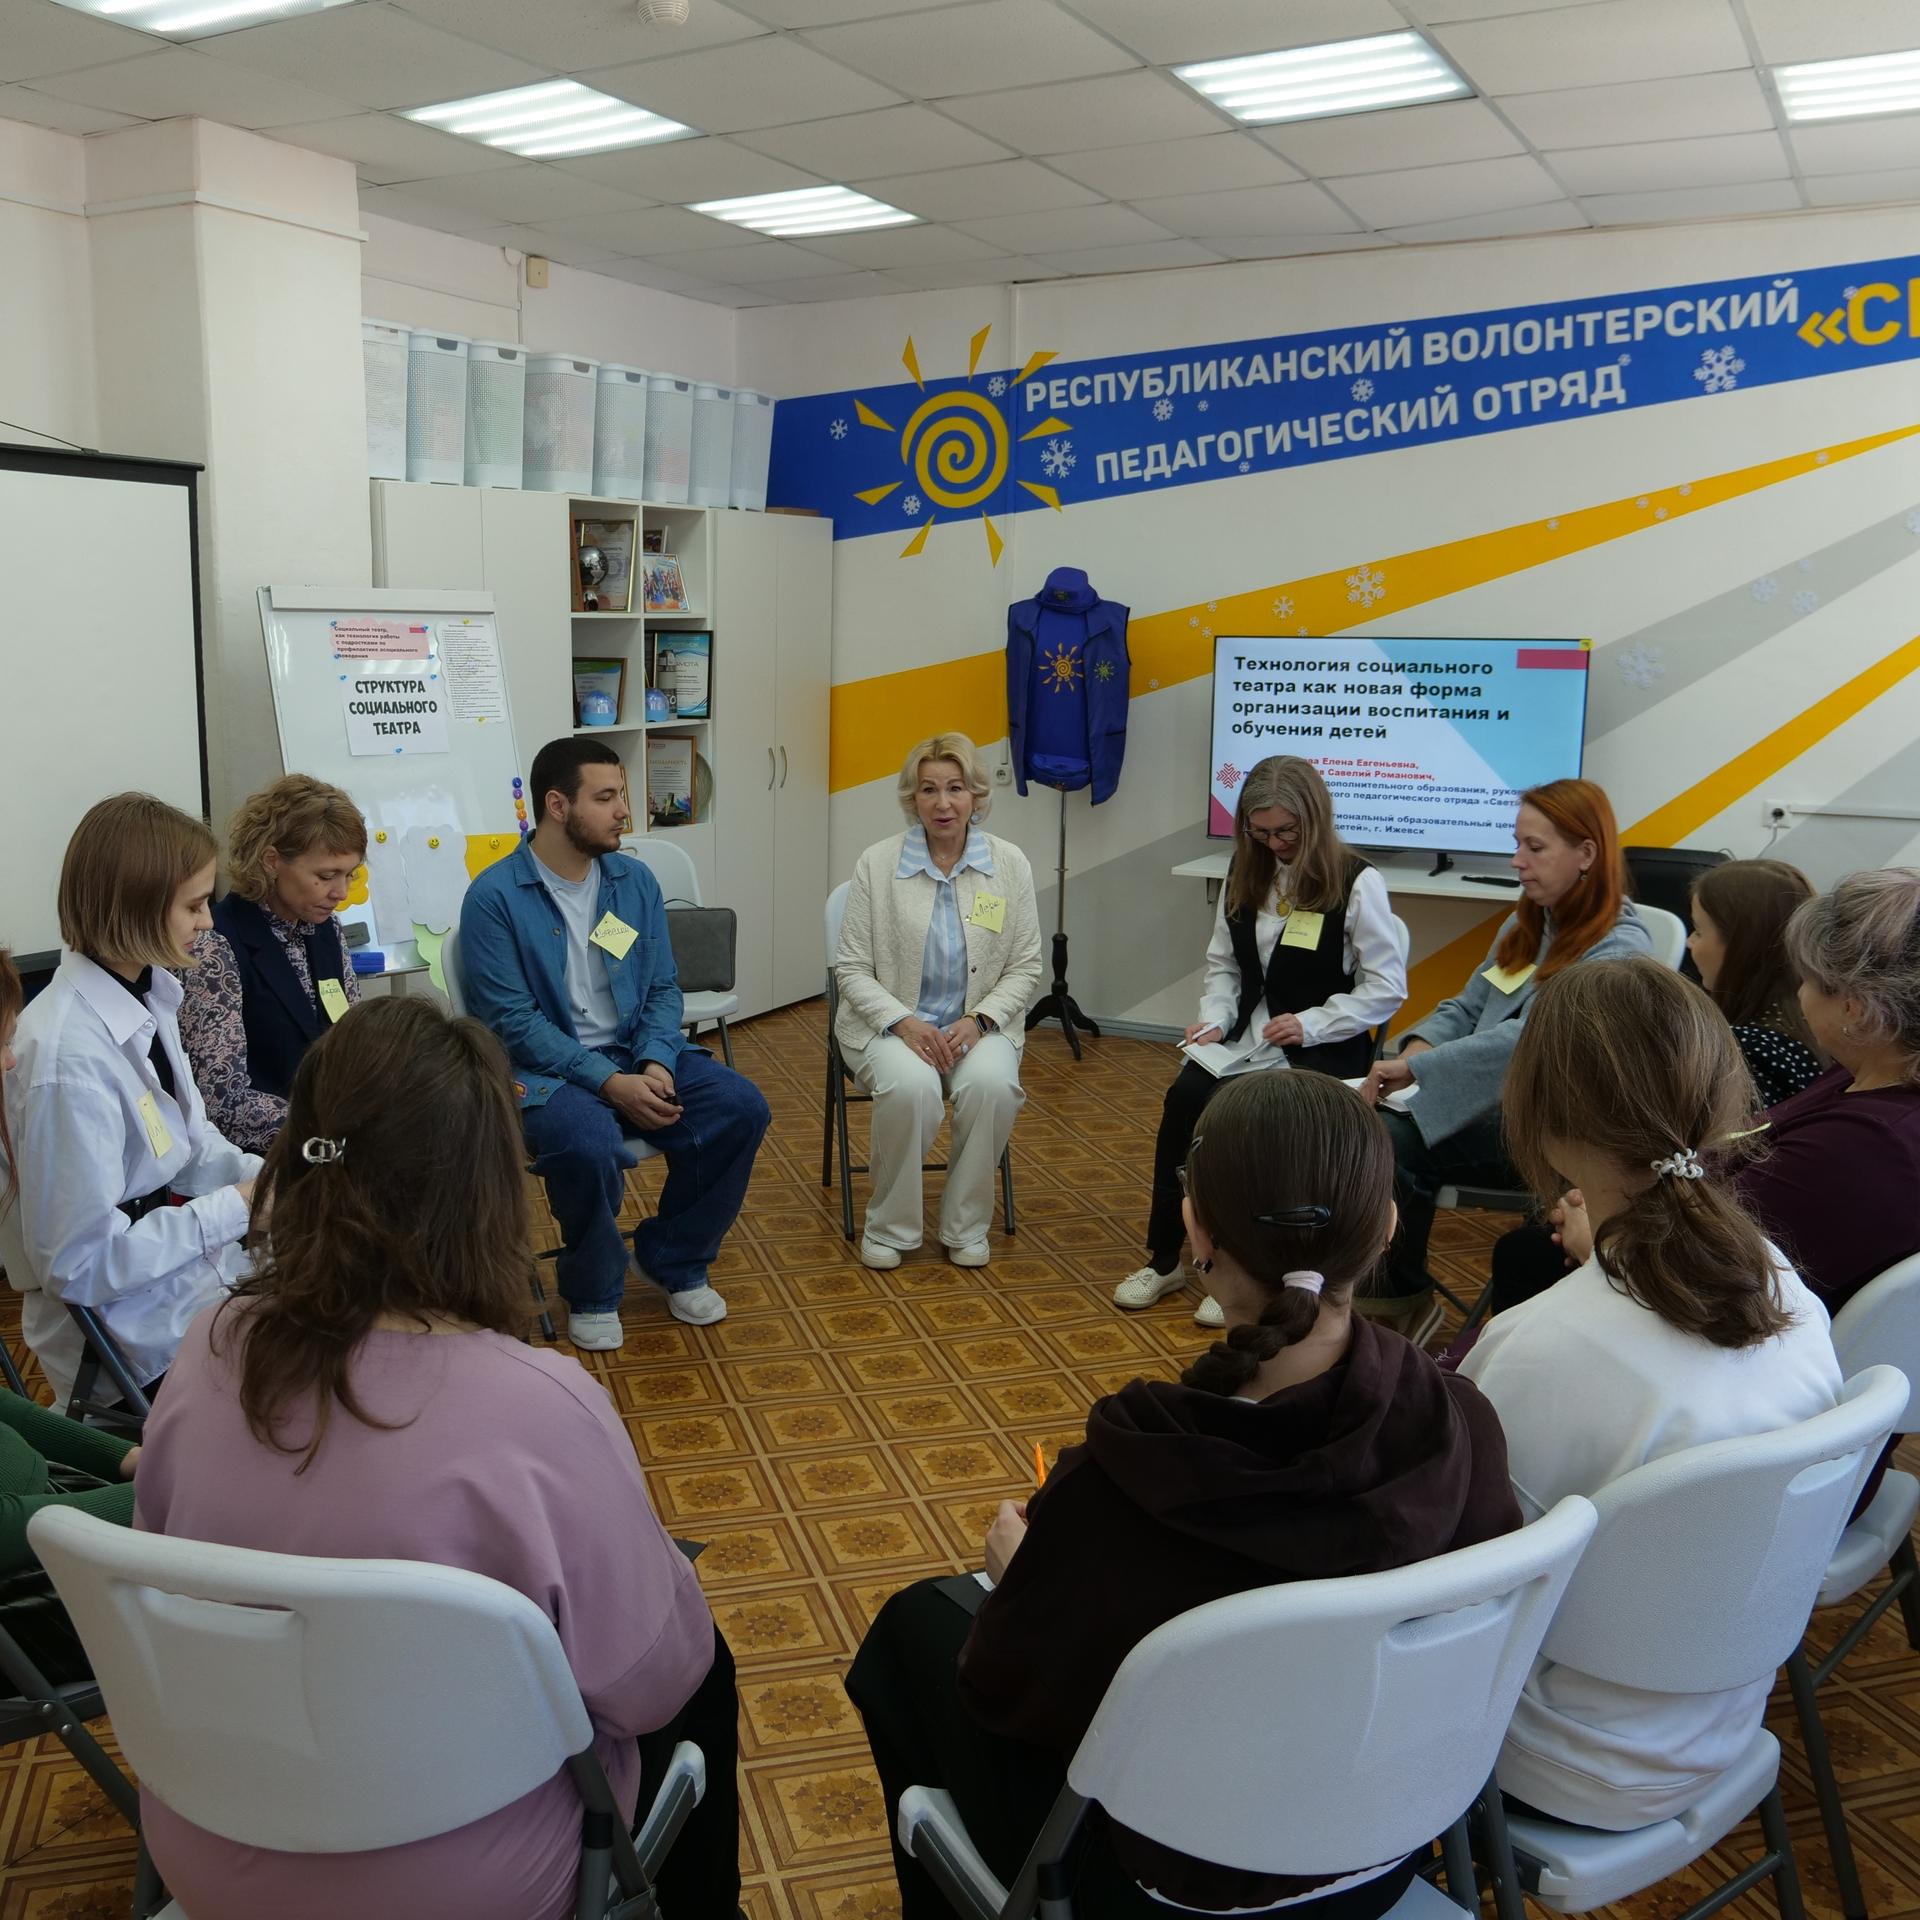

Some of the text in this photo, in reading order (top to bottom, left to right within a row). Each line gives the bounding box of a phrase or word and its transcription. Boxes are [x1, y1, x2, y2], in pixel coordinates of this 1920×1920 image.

[1025, 277, 1801, 413] РЕСПУБЛИКАНСКИЙ ВОЛОНТЕРСКИЙ
[1095, 363, 1627, 485] ПЕДАГОГИЧЕСКИЙ ОТРЯД
[1234, 656, 1493, 676] Технология социального
[355, 680, 425, 694] СТРУКТУРА
[1233, 681, 1482, 700] театра как новая форма
[349, 700, 438, 715] СОЦИАЛЬНОГО
[1232, 702, 1509, 720] организации воспитания и
[373, 721, 421, 735] ТЕАТРА
[1232, 720, 1387, 739] обучения детей
[1322, 757, 1353, 767] Елена
[1356, 758, 1419, 770] Евгеньевна,
[1327, 768, 1372, 778] Савелий
[1374, 770, 1435, 781] Романович,
[1417, 783, 1489, 796] образования,
[1353, 791, 1441, 804] педагогического
[1444, 796, 1480, 806] отряда
[1397, 815, 1492, 829] образовательный
[1385, 825, 1425, 835] Ижевск
